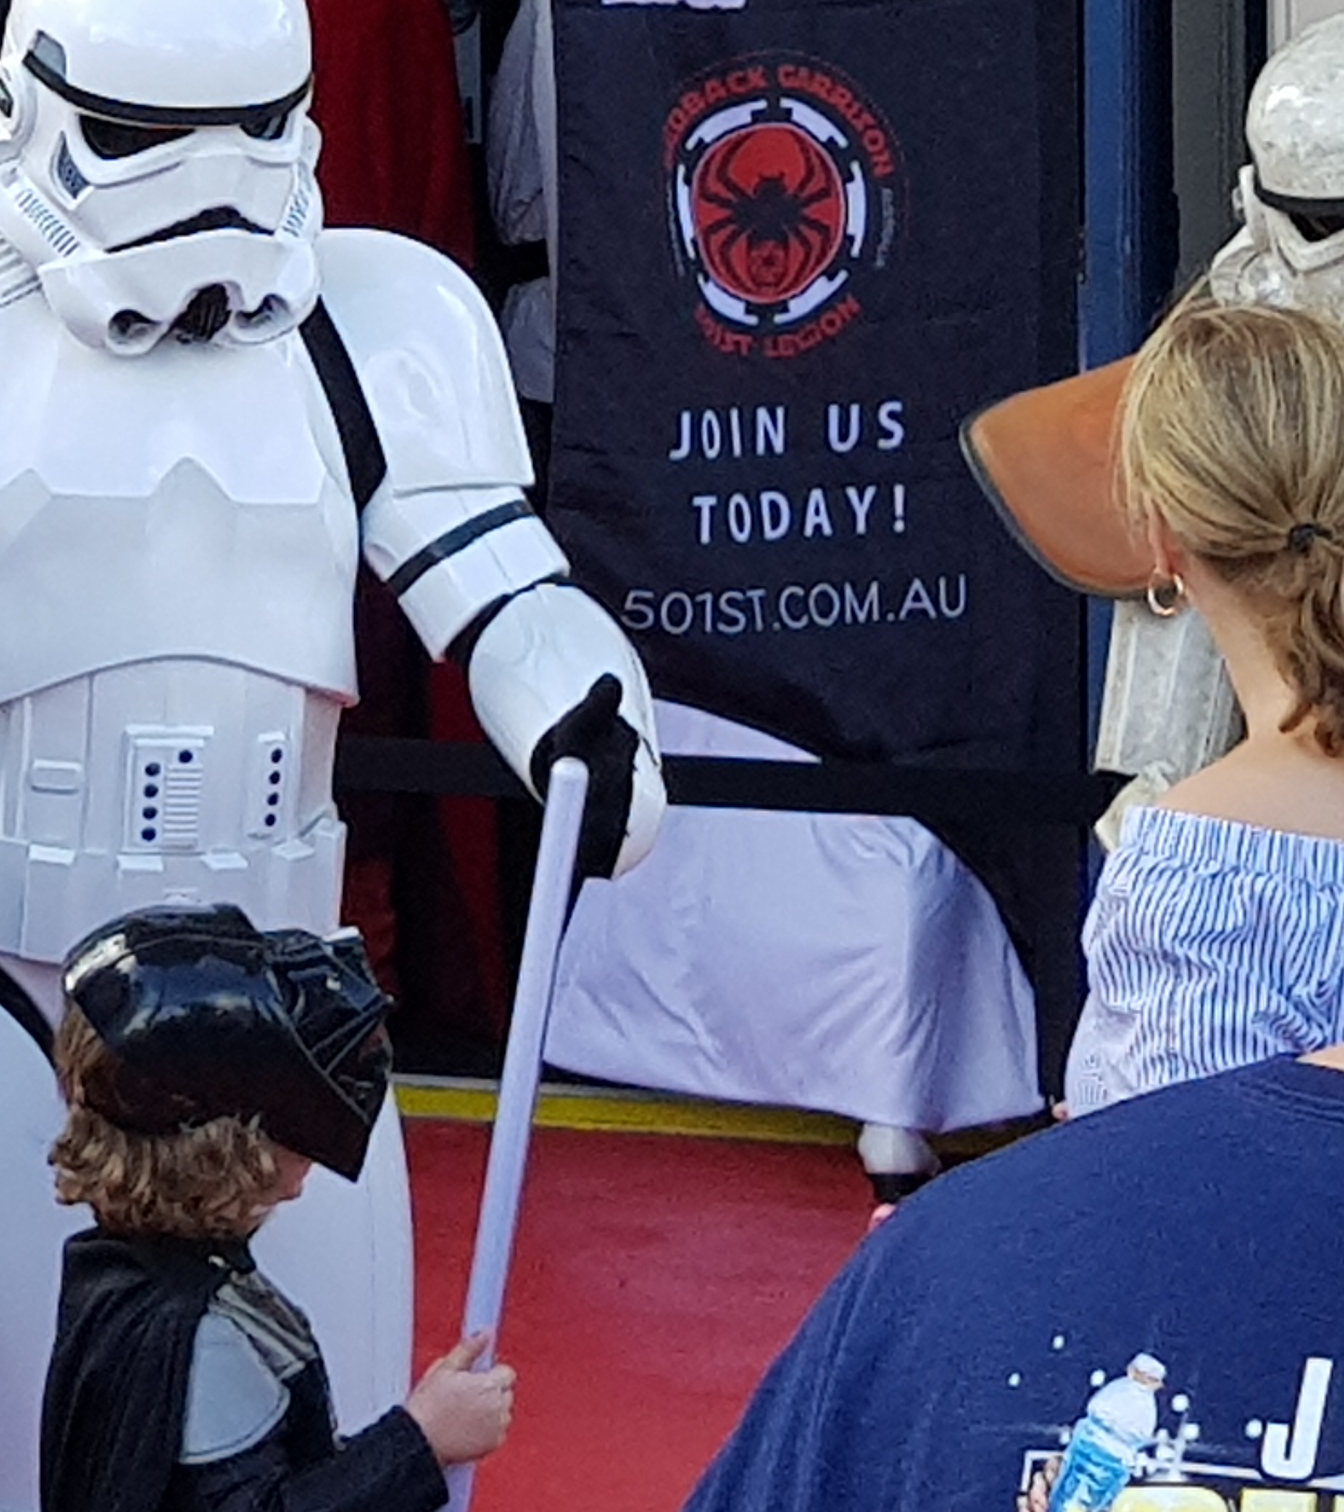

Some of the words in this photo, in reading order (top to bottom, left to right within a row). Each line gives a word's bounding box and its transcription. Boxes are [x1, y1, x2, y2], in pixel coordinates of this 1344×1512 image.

[764, 292, 862, 359] LEGION
[668, 406, 785, 461] JOIN
[827, 400, 906, 453] US
[692, 484, 906, 545] TODAY!
[621, 572, 967, 635] 501ST.COM.AU
